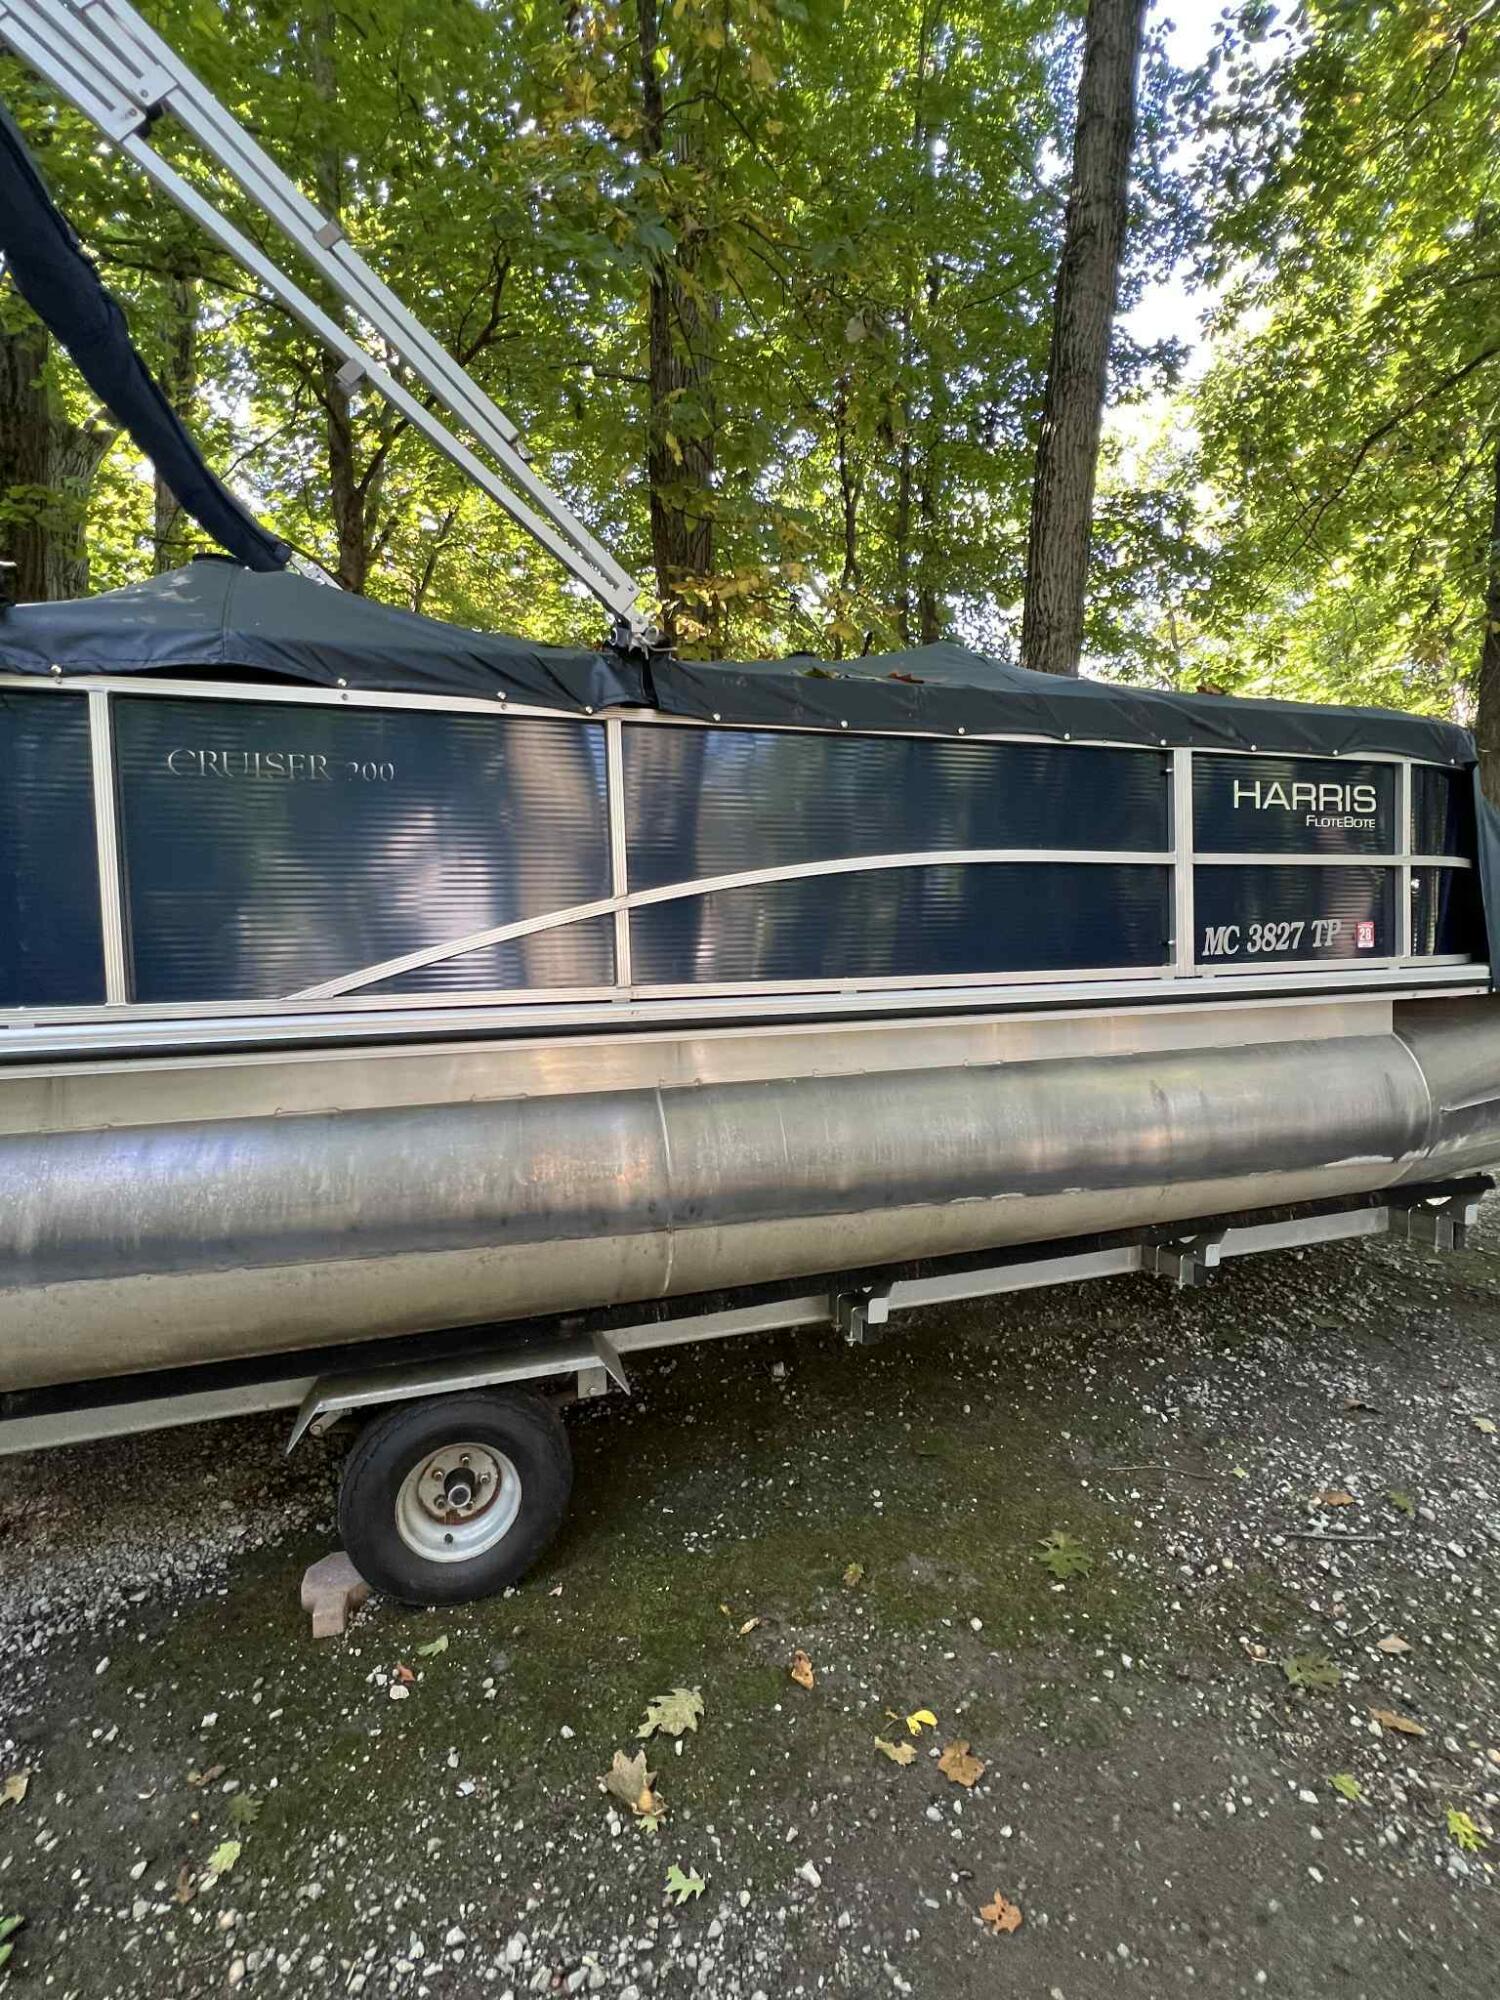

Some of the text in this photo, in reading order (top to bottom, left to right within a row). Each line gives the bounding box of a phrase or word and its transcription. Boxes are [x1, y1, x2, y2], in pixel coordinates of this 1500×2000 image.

[167, 749, 332, 781] CRUISER
[1233, 779, 1377, 813] HARRIS
[1202, 919, 1342, 956] MC 3827 TP
